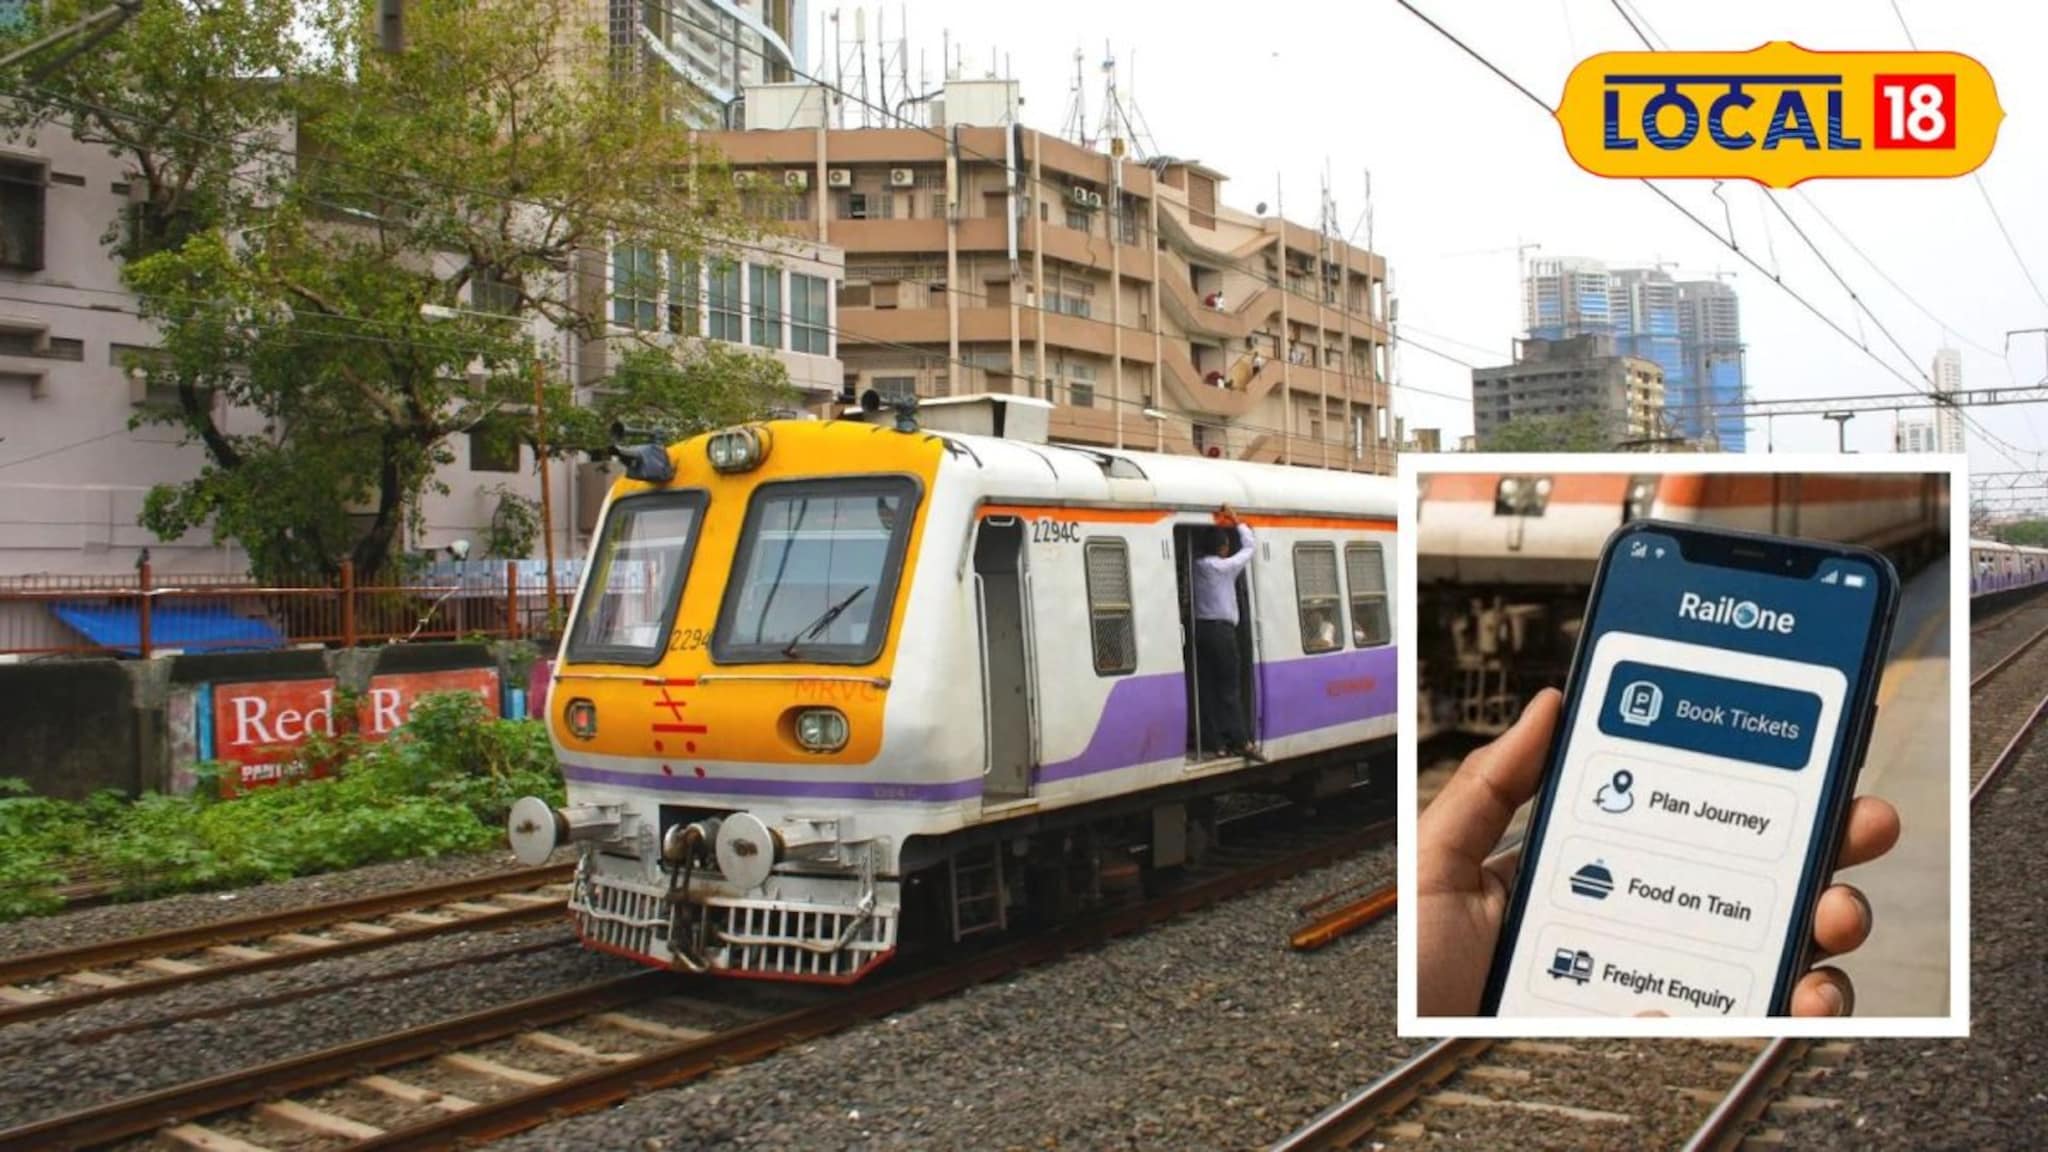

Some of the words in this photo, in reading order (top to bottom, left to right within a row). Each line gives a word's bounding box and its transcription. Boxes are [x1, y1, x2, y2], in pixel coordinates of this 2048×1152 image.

[1031, 519, 1081, 544] 2294C
[1678, 591, 1796, 635] RailOne
[231, 687, 338, 746] Red
[1676, 699, 1727, 726] Book
[1730, 708, 1801, 741] Tickets
[1649, 790, 1691, 816] Plan
[1693, 801, 1771, 836] Journey
[1627, 877, 1676, 904] Food
[1677, 892, 1702, 911] on
[1706, 894, 1752, 922] Train
[1602, 962, 1665, 995] Freight
[1667, 978, 1737, 1015] Enquiry
